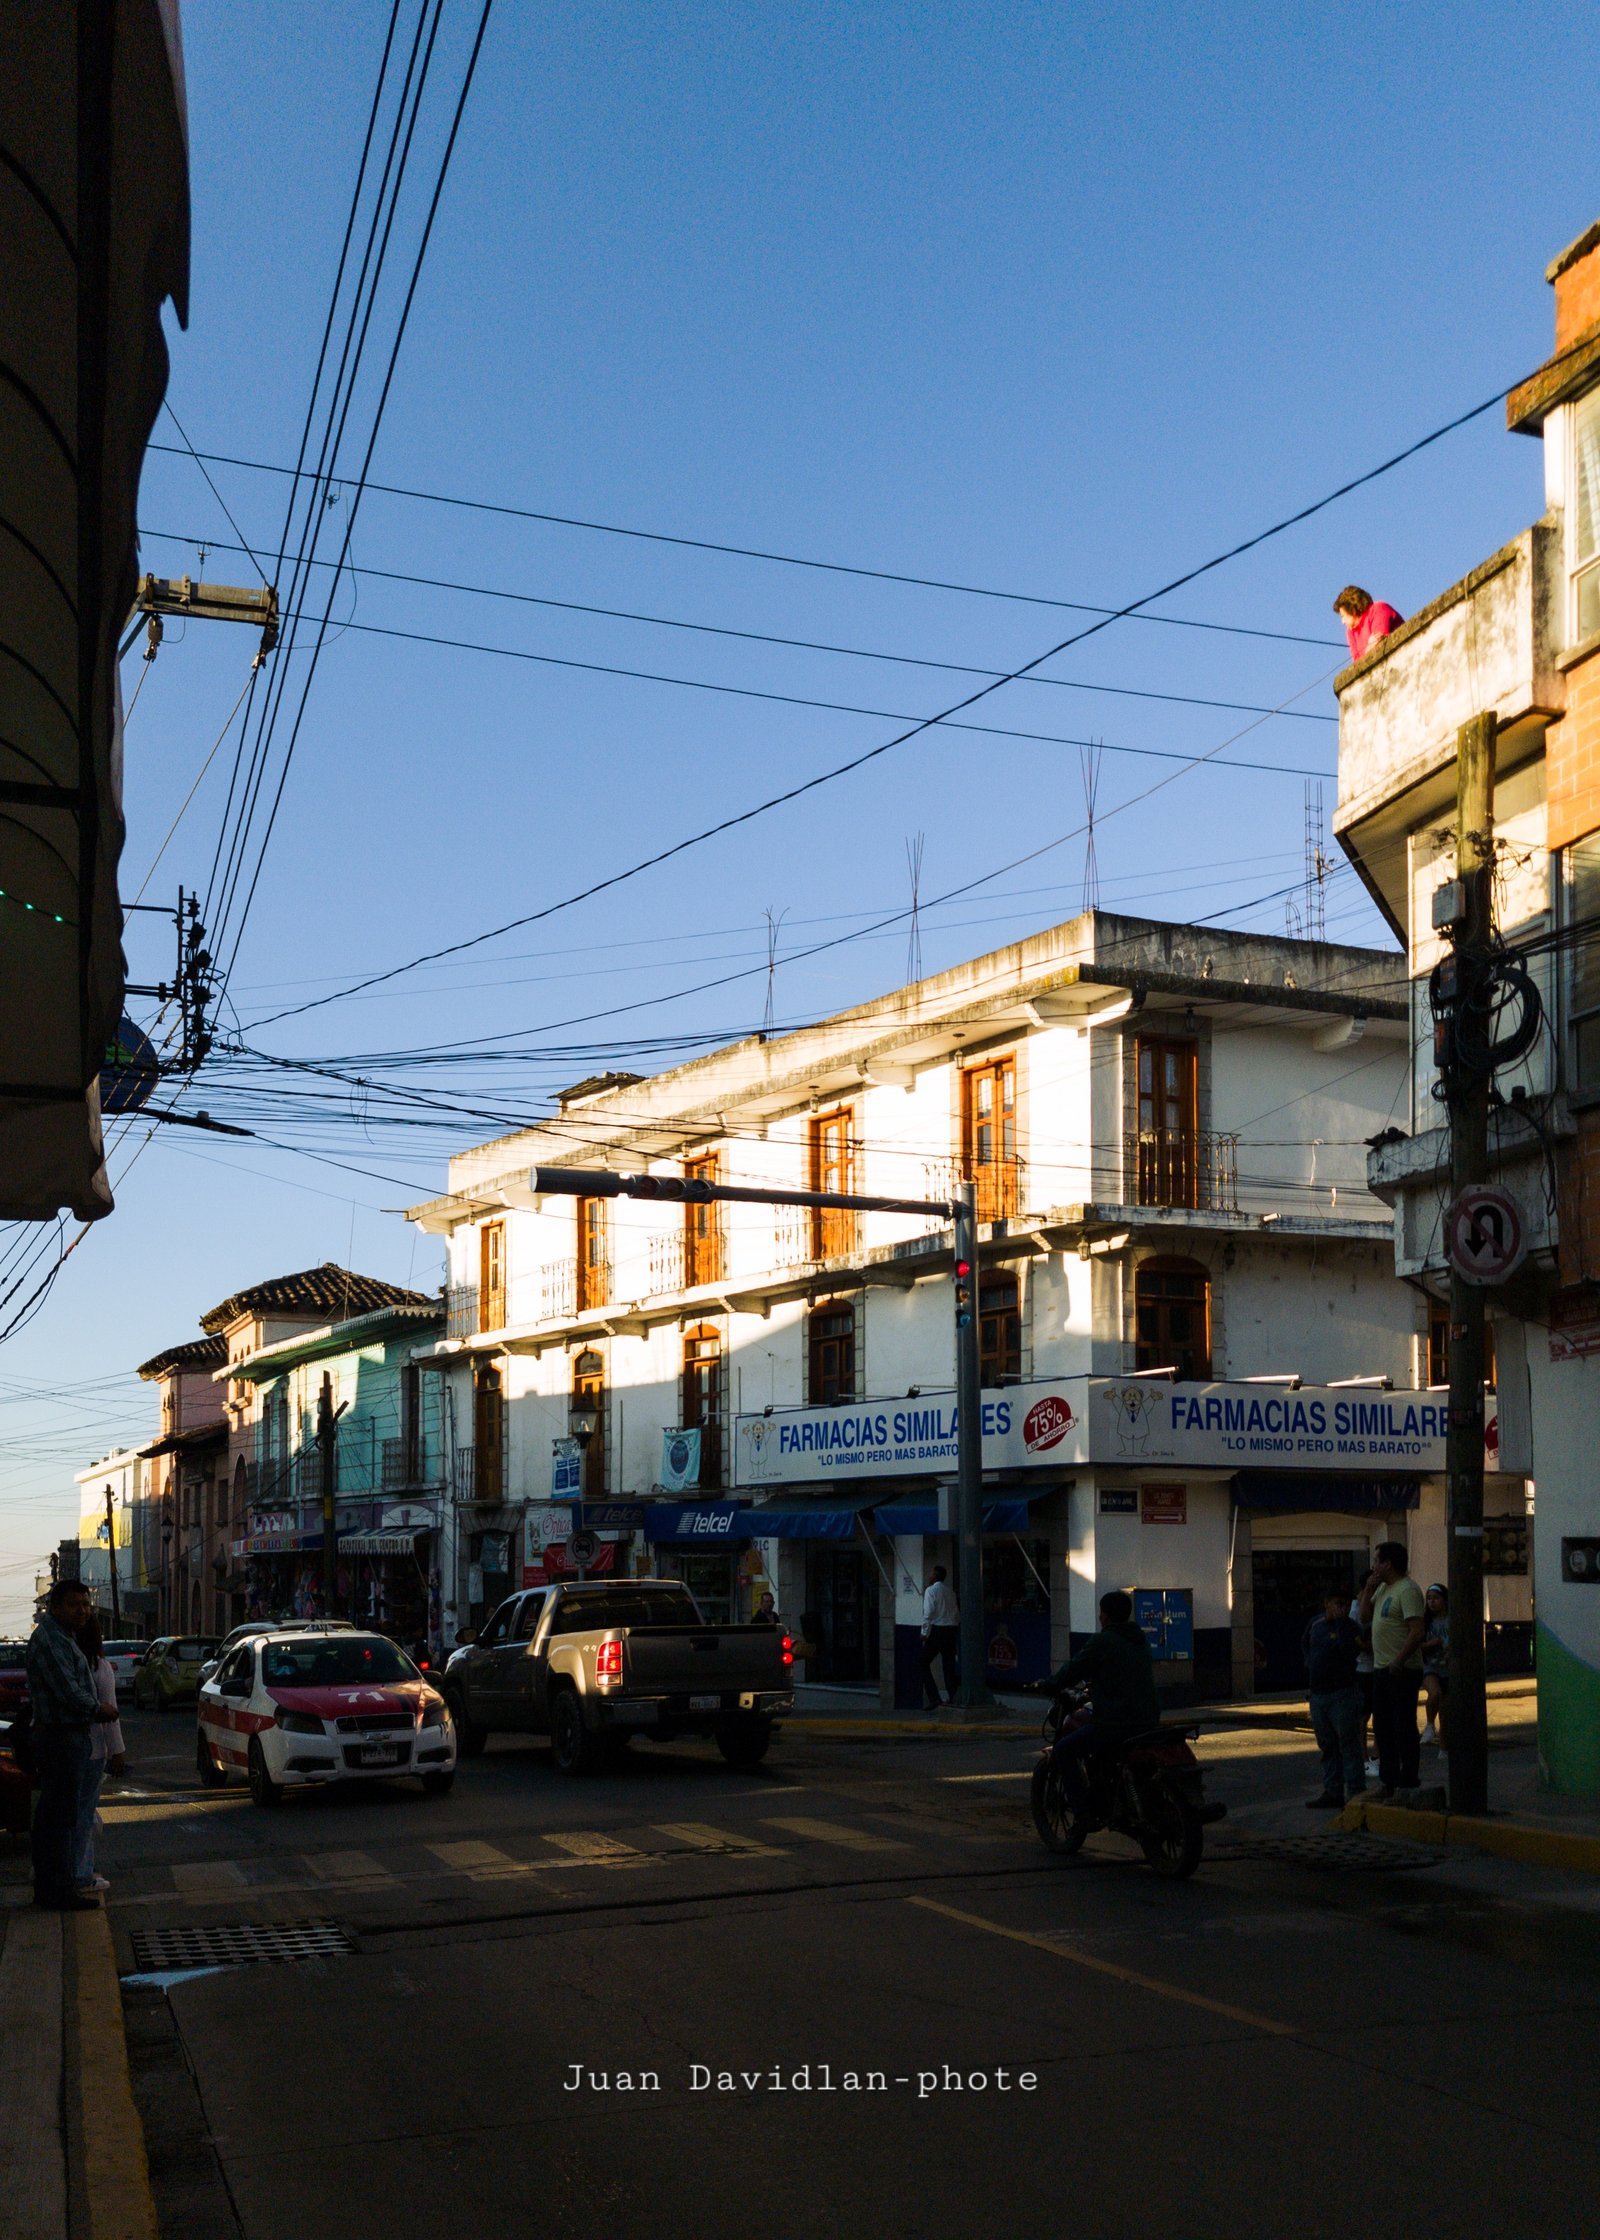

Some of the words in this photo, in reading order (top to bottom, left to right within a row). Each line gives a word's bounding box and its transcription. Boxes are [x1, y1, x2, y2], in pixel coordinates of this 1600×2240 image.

[1032, 1399, 1052, 1414] HASTA
[1171, 1396, 1327, 1435] FARMACIAS
[1334, 1401, 1449, 1438] SIMILARE
[780, 1414, 888, 1454] FARMACIAS
[894, 1401, 1012, 1444] SIMILAES
[1029, 1404, 1063, 1438] 75%
[1031, 1440, 1040, 1450] DE
[1043, 1421, 1071, 1442] AHORRO
[1250, 1437, 1293, 1451] MISMO
[1298, 1439, 1334, 1453] PERO
[1338, 1440, 1365, 1453] MAS
[836, 1451, 864, 1465] MISMO
[867, 1448, 892, 1463] PERO
[895, 1446, 916, 1460] MAS
[692, 1511, 735, 1533] telcel
[337, 1690, 386, 1704] 71
